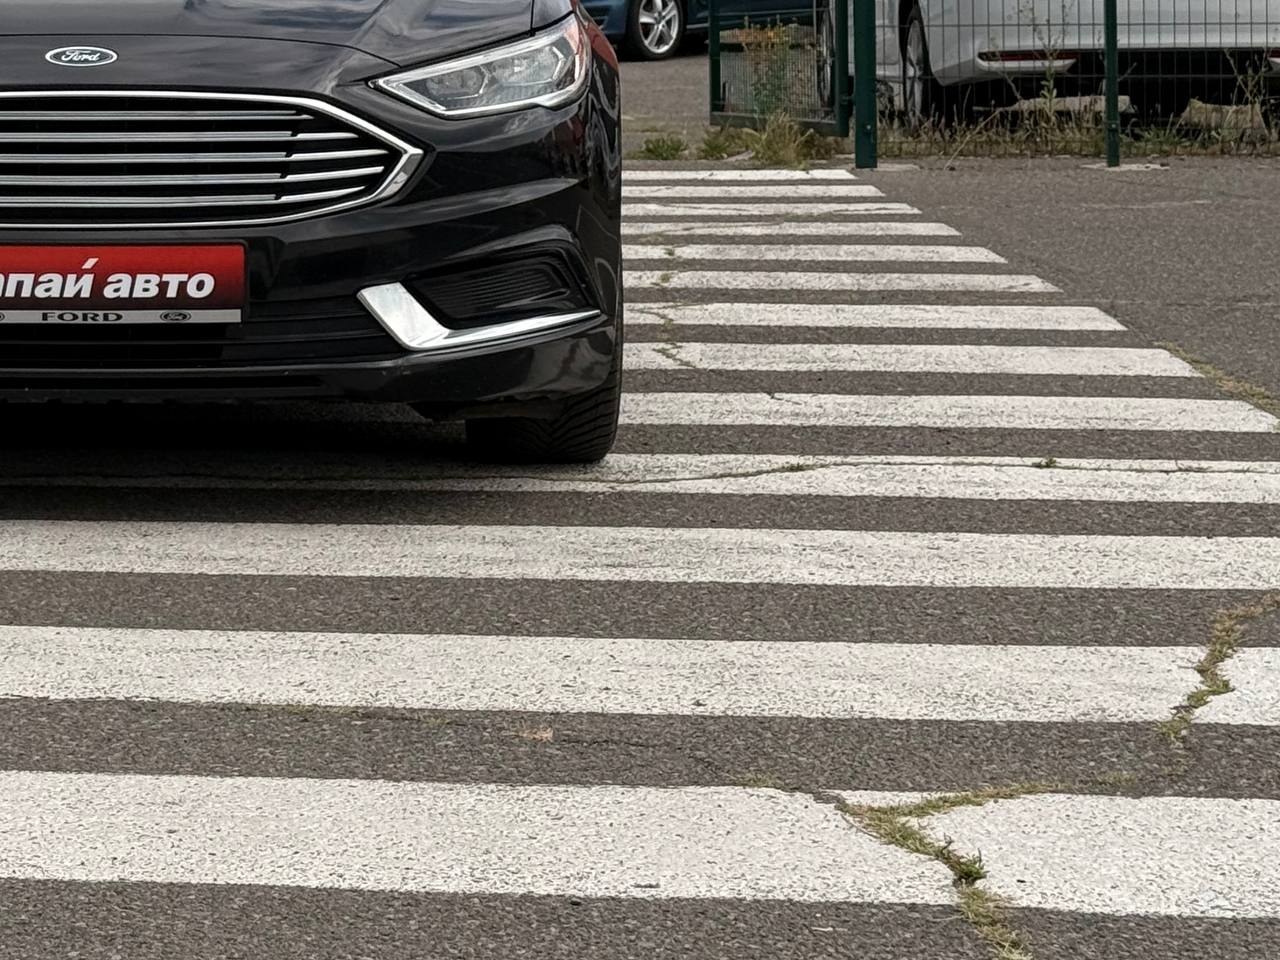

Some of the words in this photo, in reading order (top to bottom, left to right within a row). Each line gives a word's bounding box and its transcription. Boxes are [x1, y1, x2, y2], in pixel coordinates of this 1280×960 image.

[61, 49, 101, 61] Ford
[102, 272, 215, 299] авто
[41, 311, 123, 323] FORD
